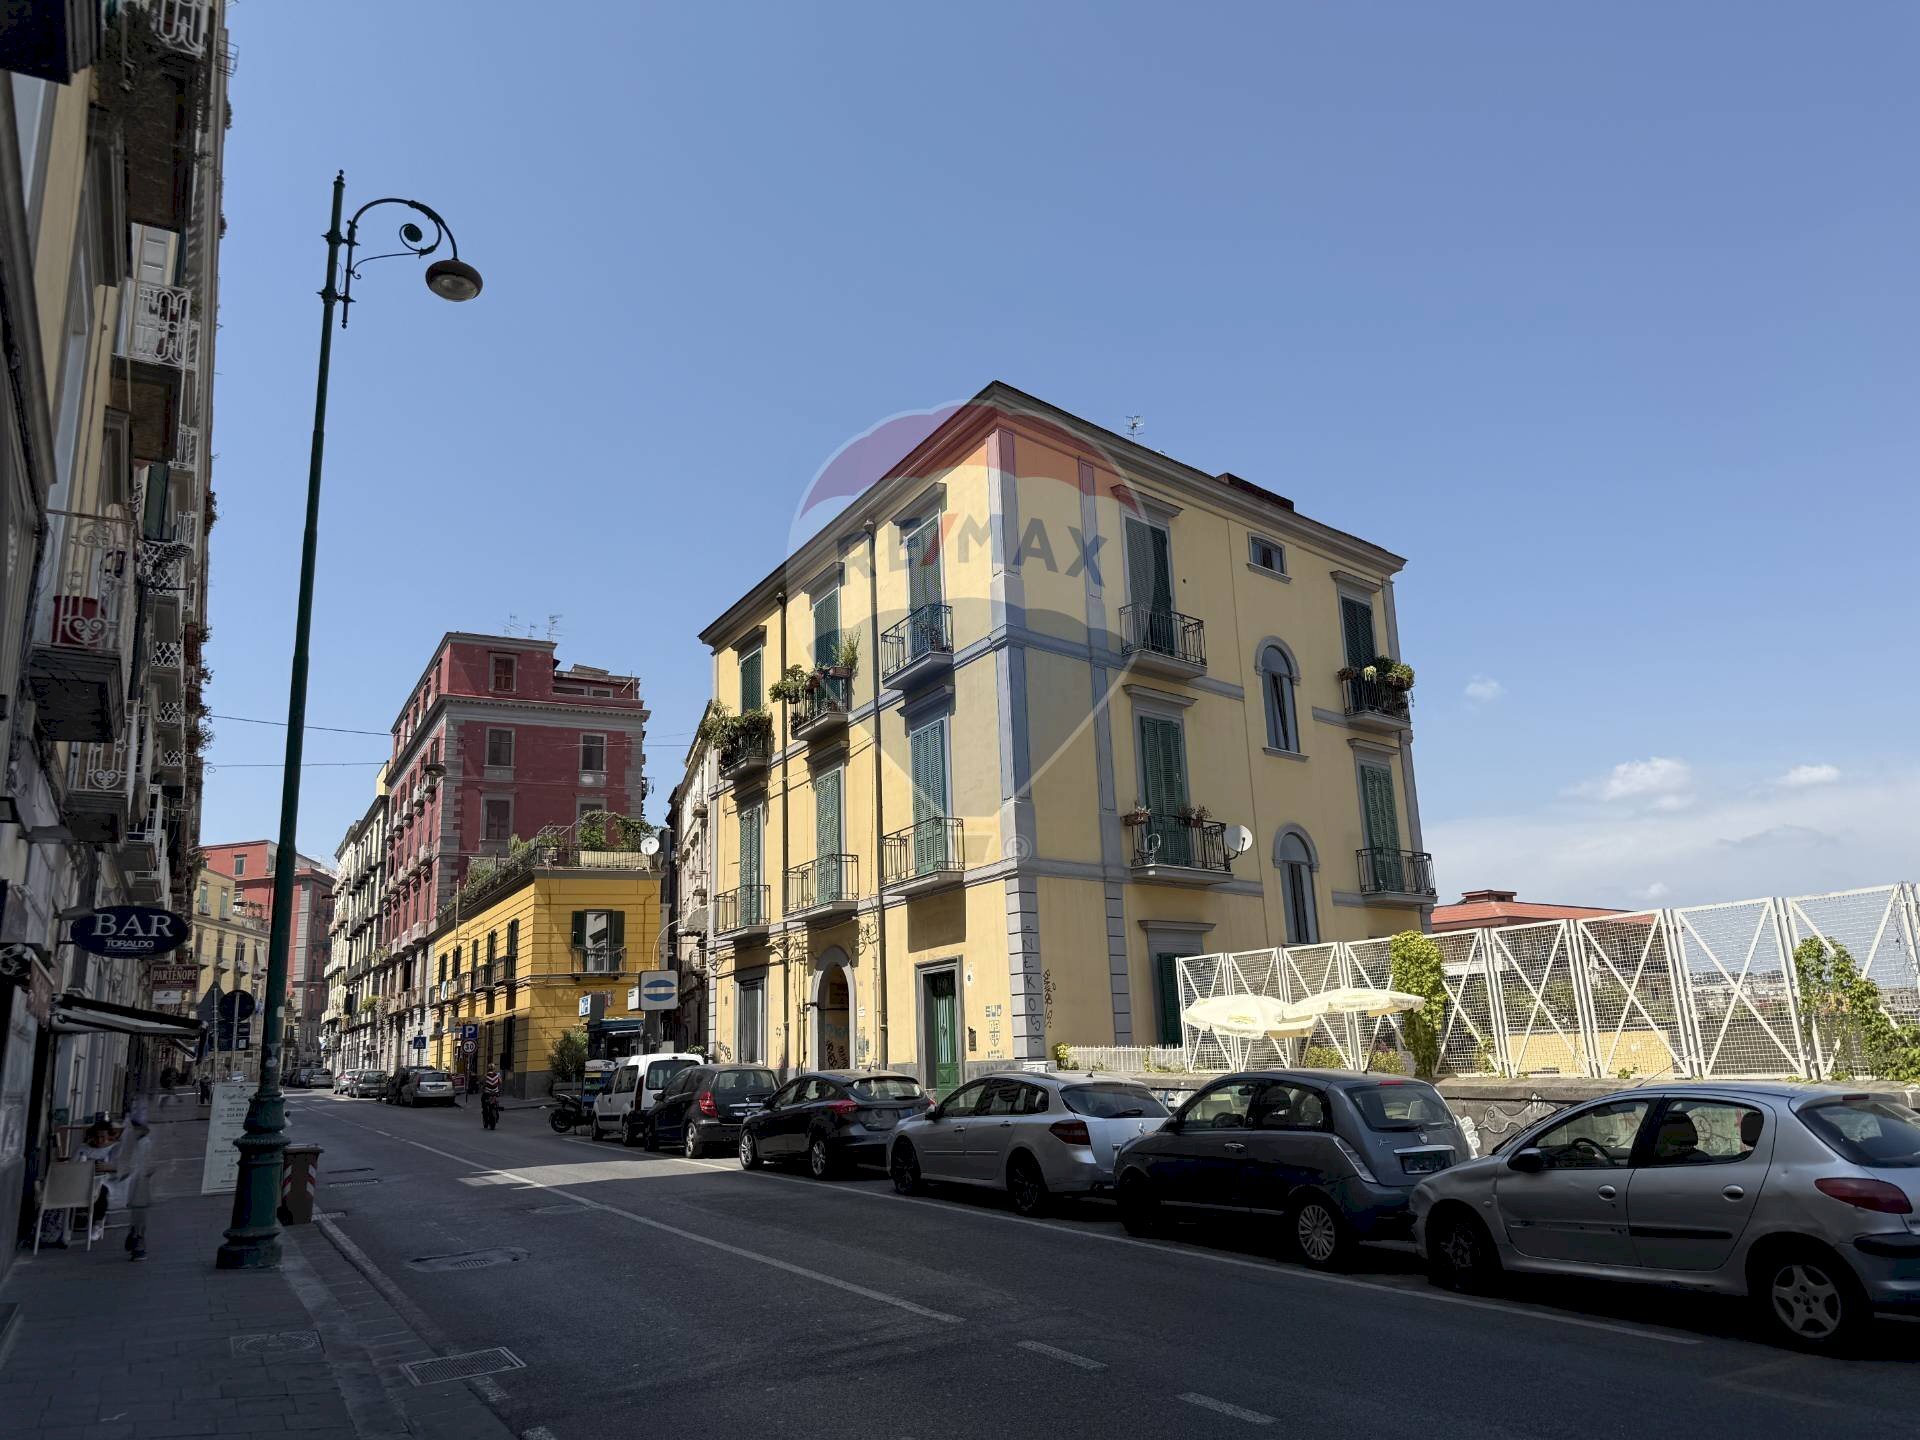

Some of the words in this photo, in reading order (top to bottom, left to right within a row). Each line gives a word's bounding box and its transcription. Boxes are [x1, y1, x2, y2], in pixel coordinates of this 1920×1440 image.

[90, 913, 174, 938] BAR
[105, 939, 154, 948] TORALDO
[152, 969, 198, 981] PARTENOPE
[465, 1025, 475, 1038] P
[464, 1043, 474, 1051] 30
